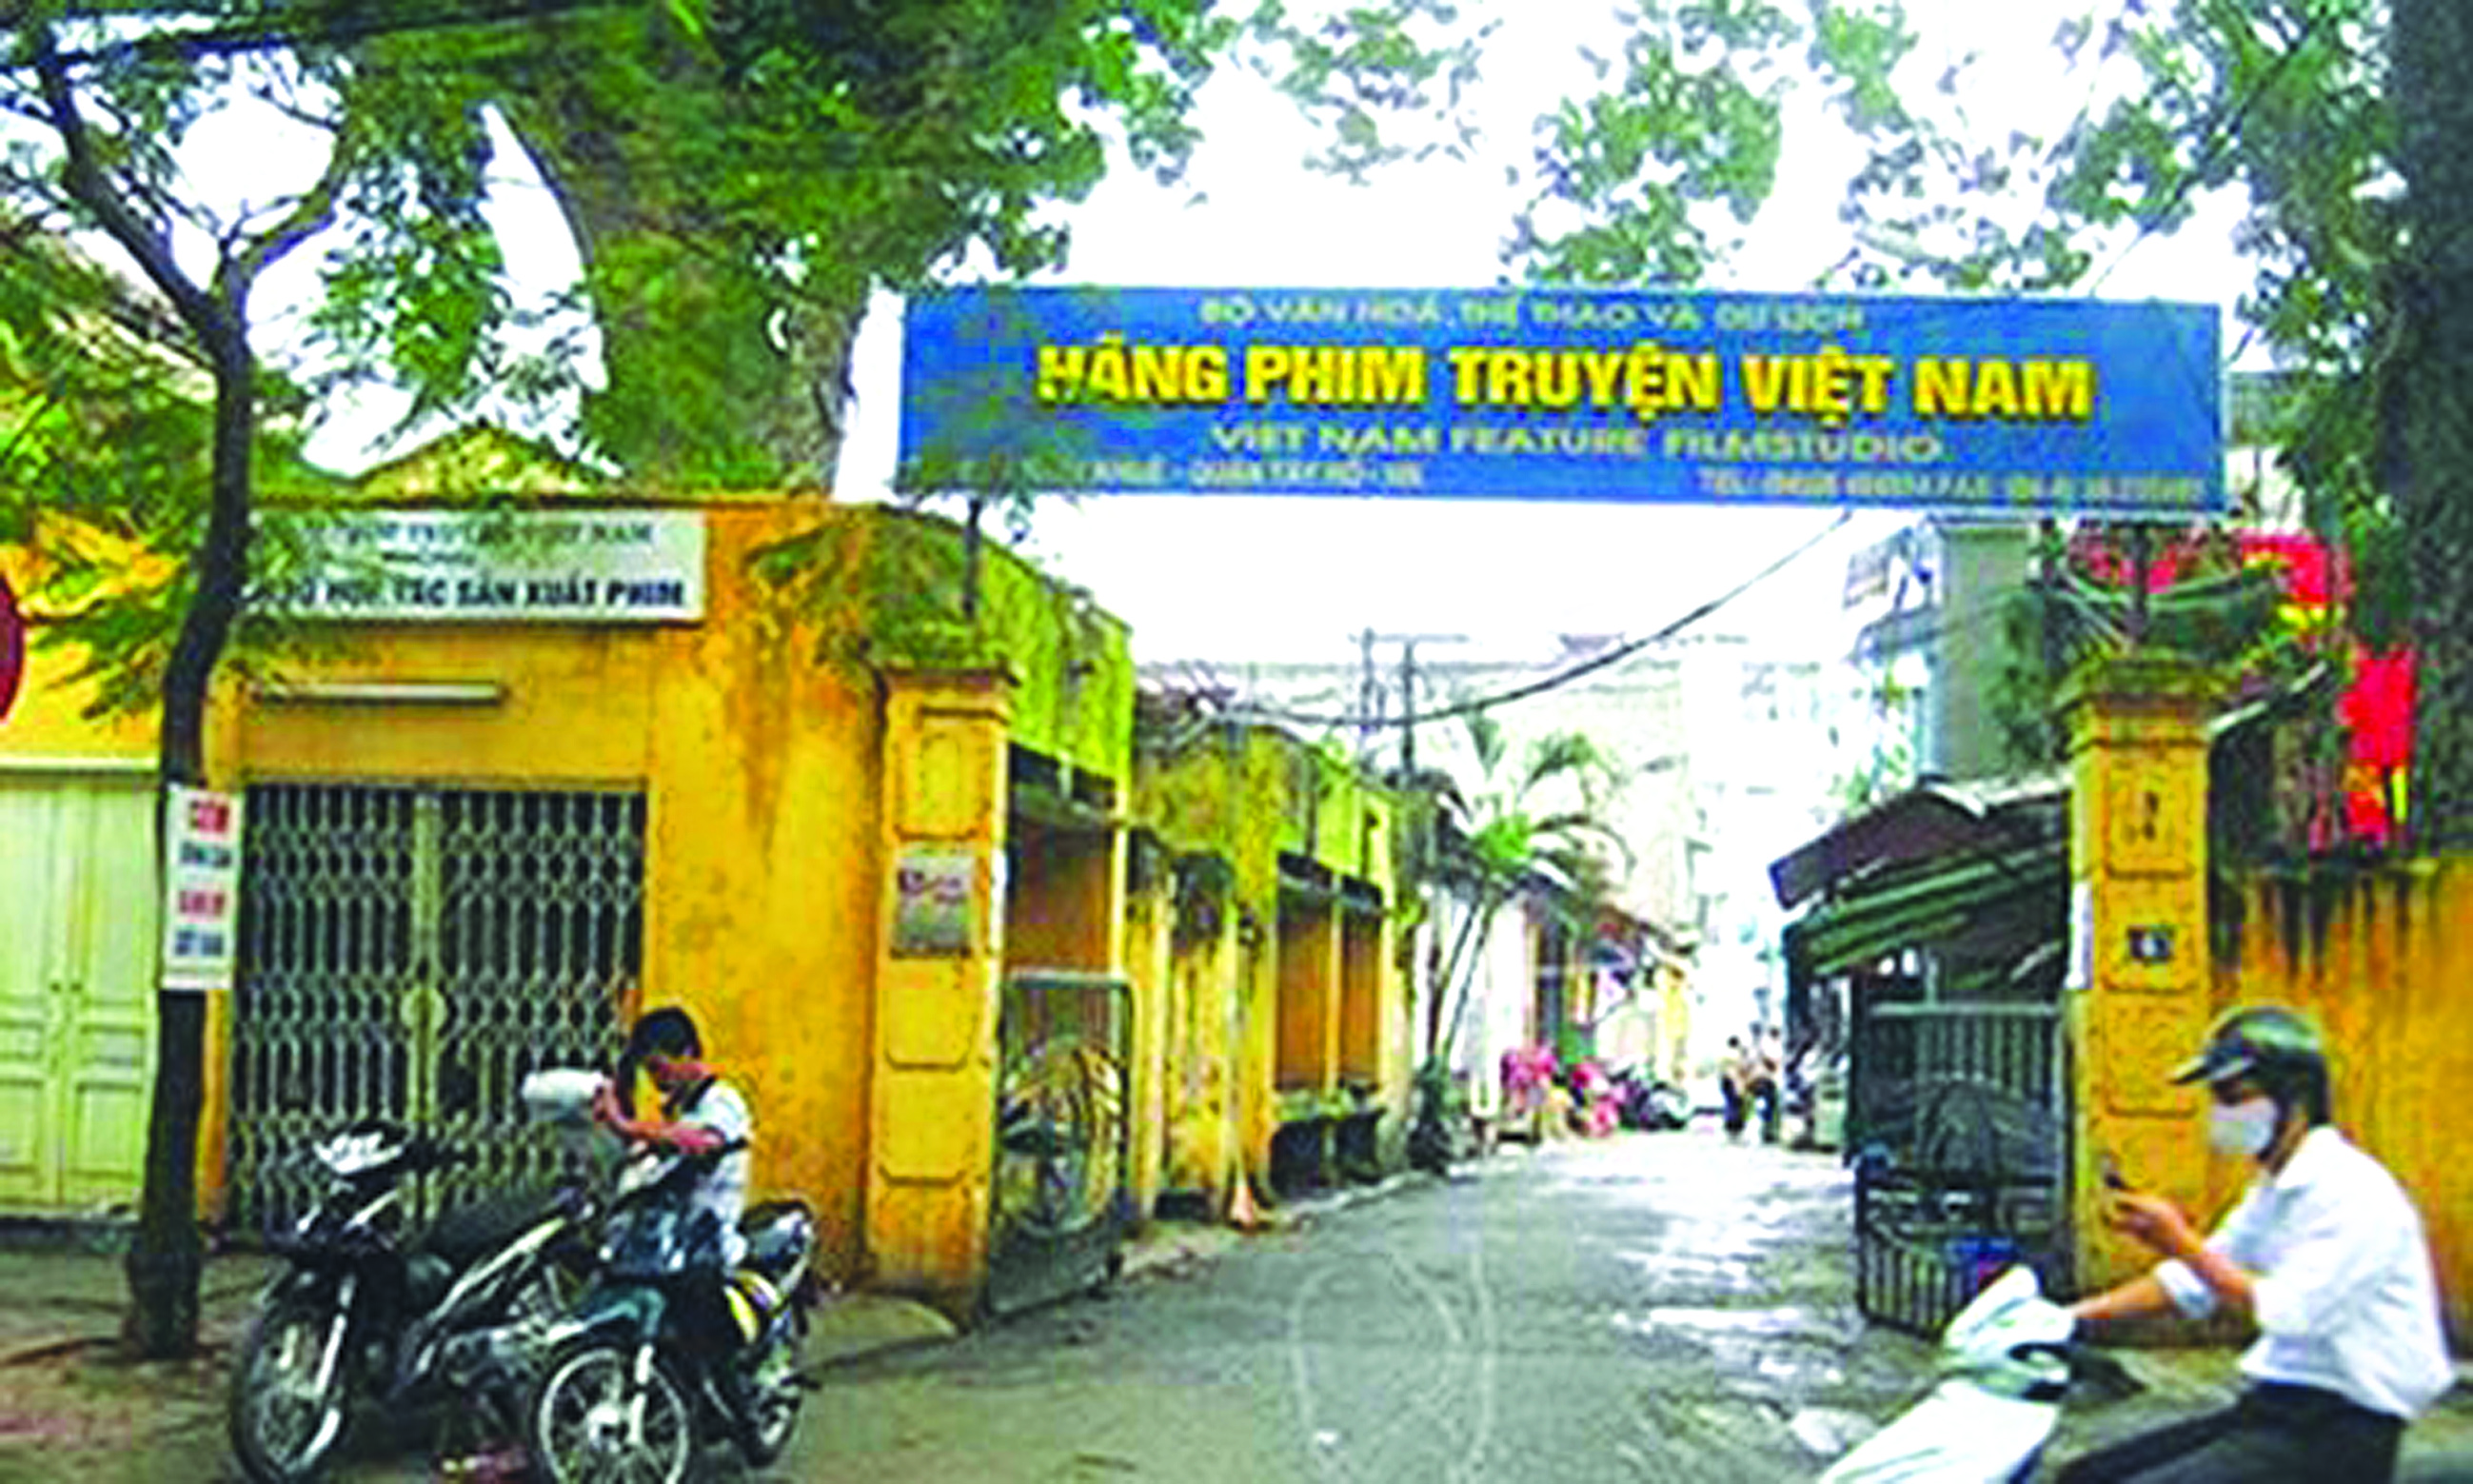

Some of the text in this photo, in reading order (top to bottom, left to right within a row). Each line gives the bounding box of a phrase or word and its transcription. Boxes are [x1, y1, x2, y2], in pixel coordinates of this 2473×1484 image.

[1244, 344, 1424, 406] PHIM
[1447, 340, 1721, 425] TRUYỆN
[1742, 346, 1895, 427] VIỆT
[1910, 358, 2095, 422] NAM
[1450, 426, 1648, 456] FEATURE
[605, 578, 683, 606] PHIM
